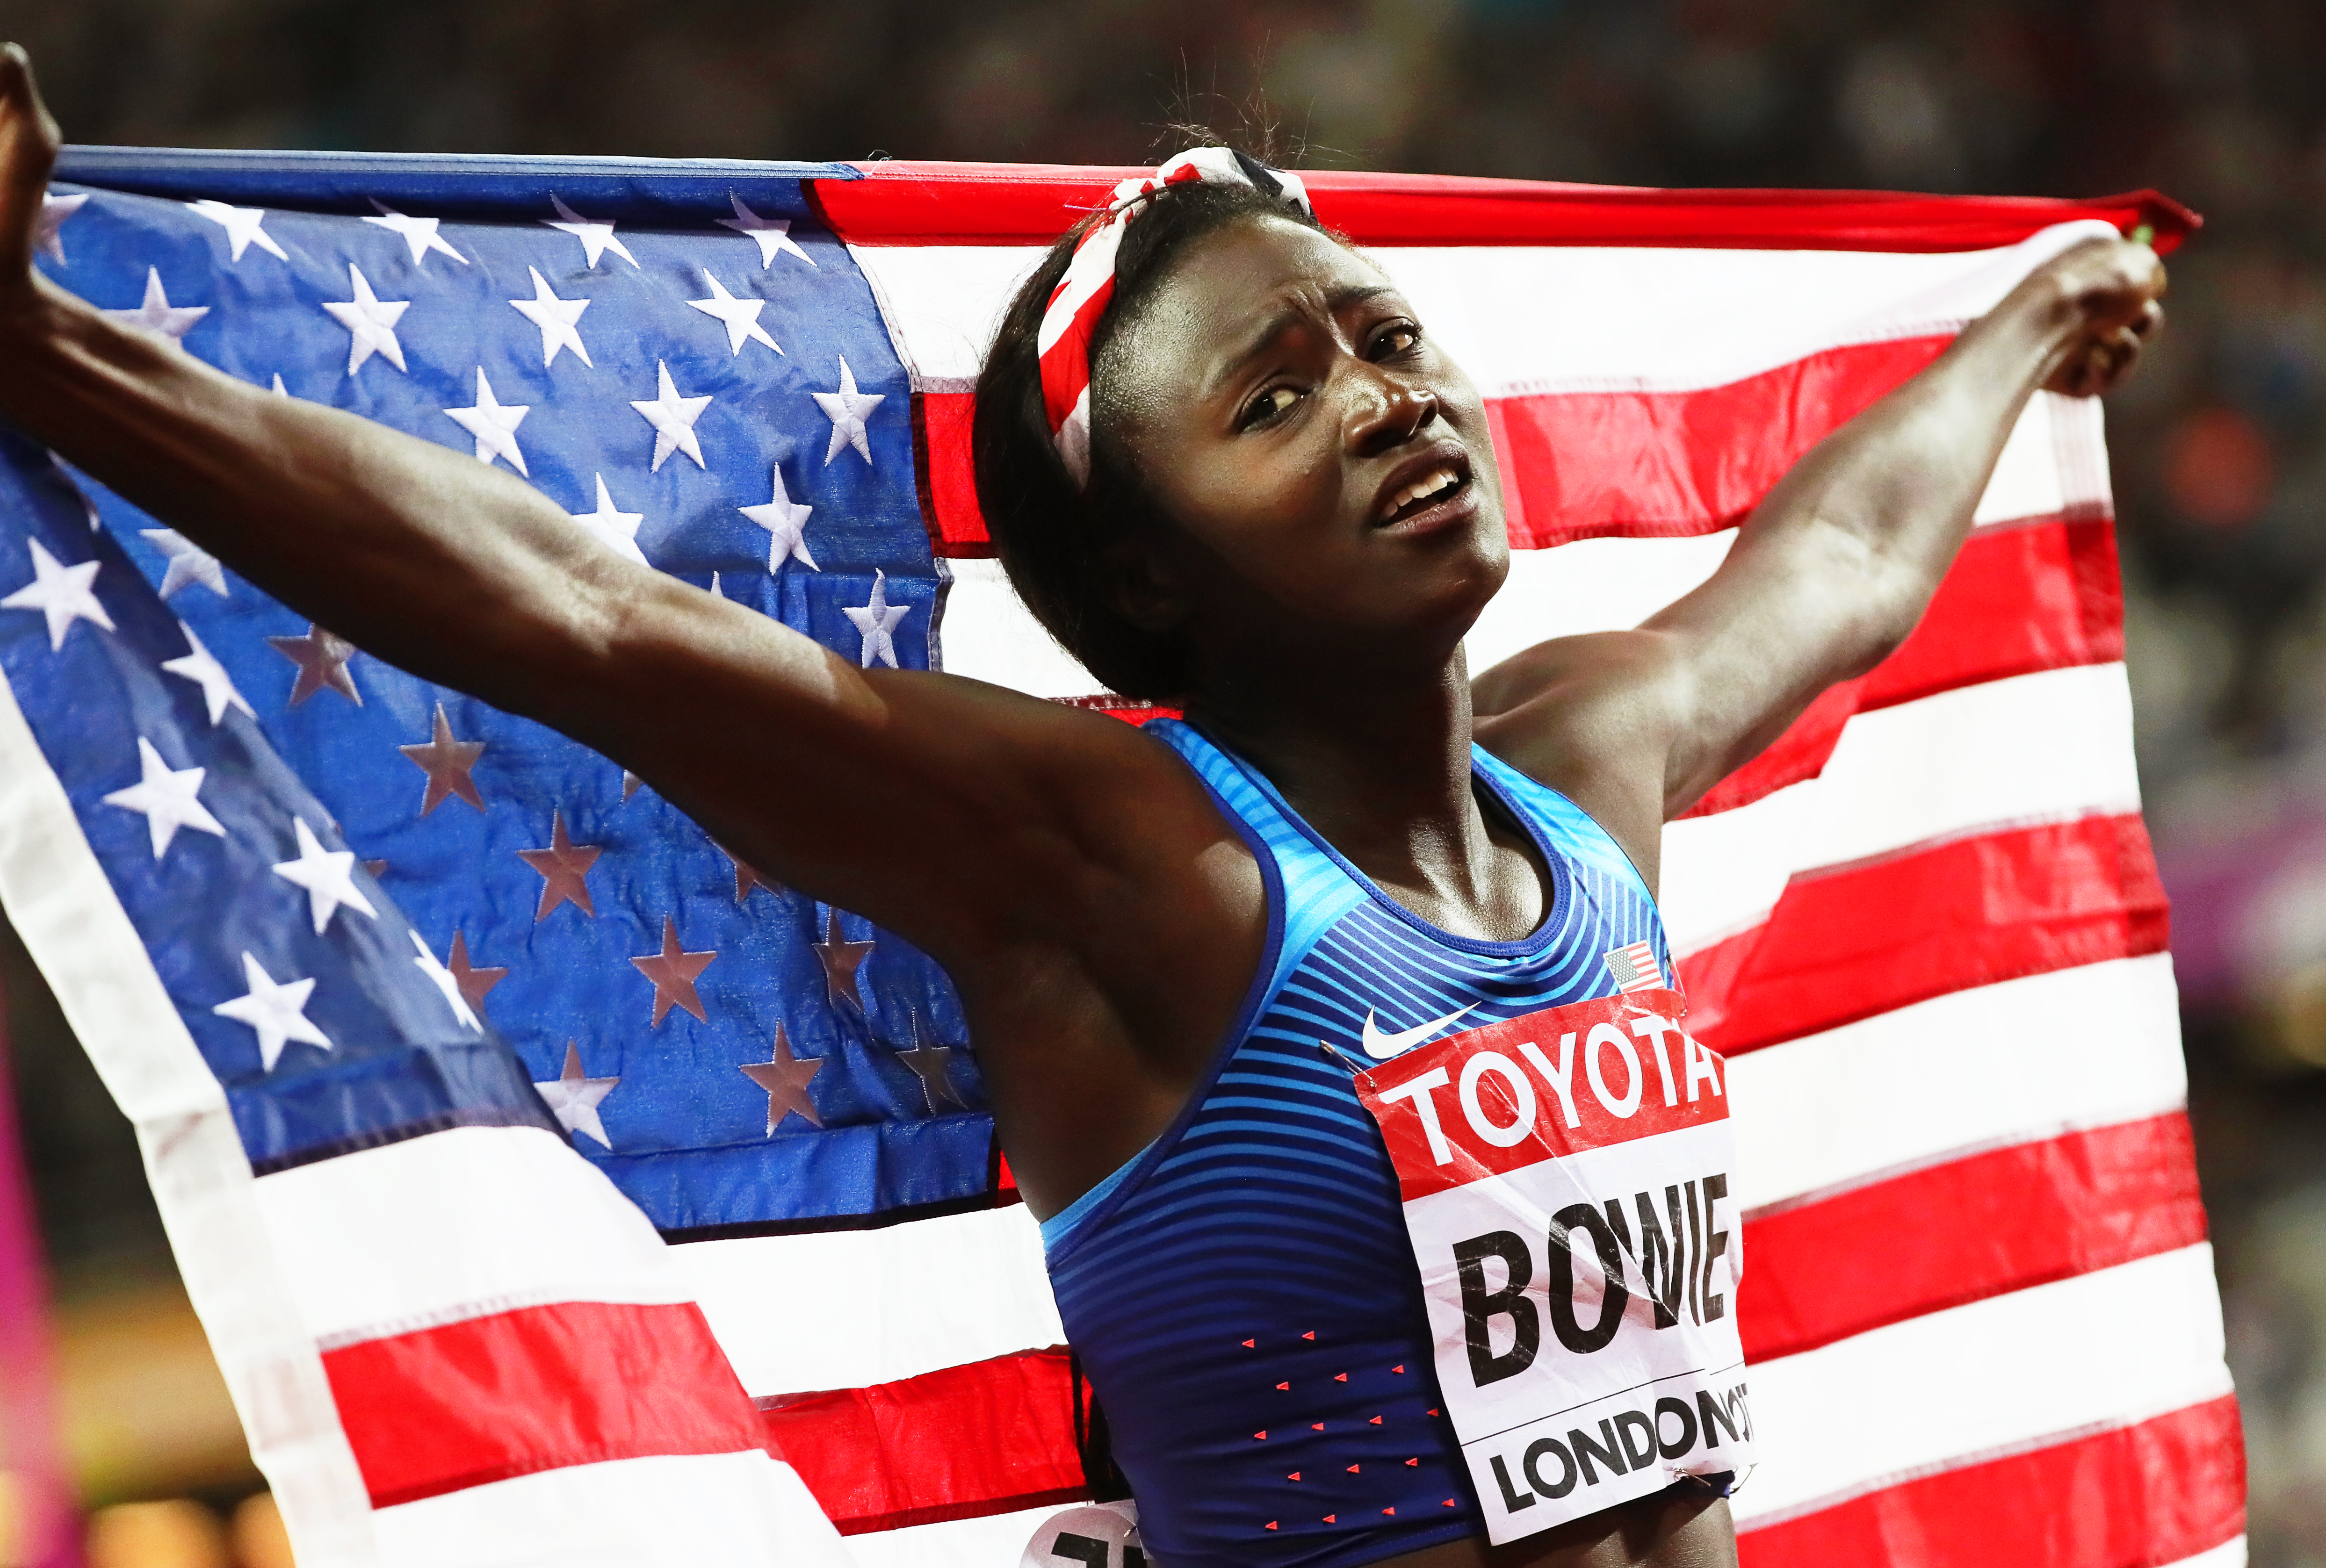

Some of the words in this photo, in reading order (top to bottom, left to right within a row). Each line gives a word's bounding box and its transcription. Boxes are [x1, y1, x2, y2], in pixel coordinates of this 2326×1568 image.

[1377, 1015, 1722, 1166] TOYOTA
[1452, 1172, 1728, 1388] BOWIE
[1489, 1388, 1740, 1513] LONDON
